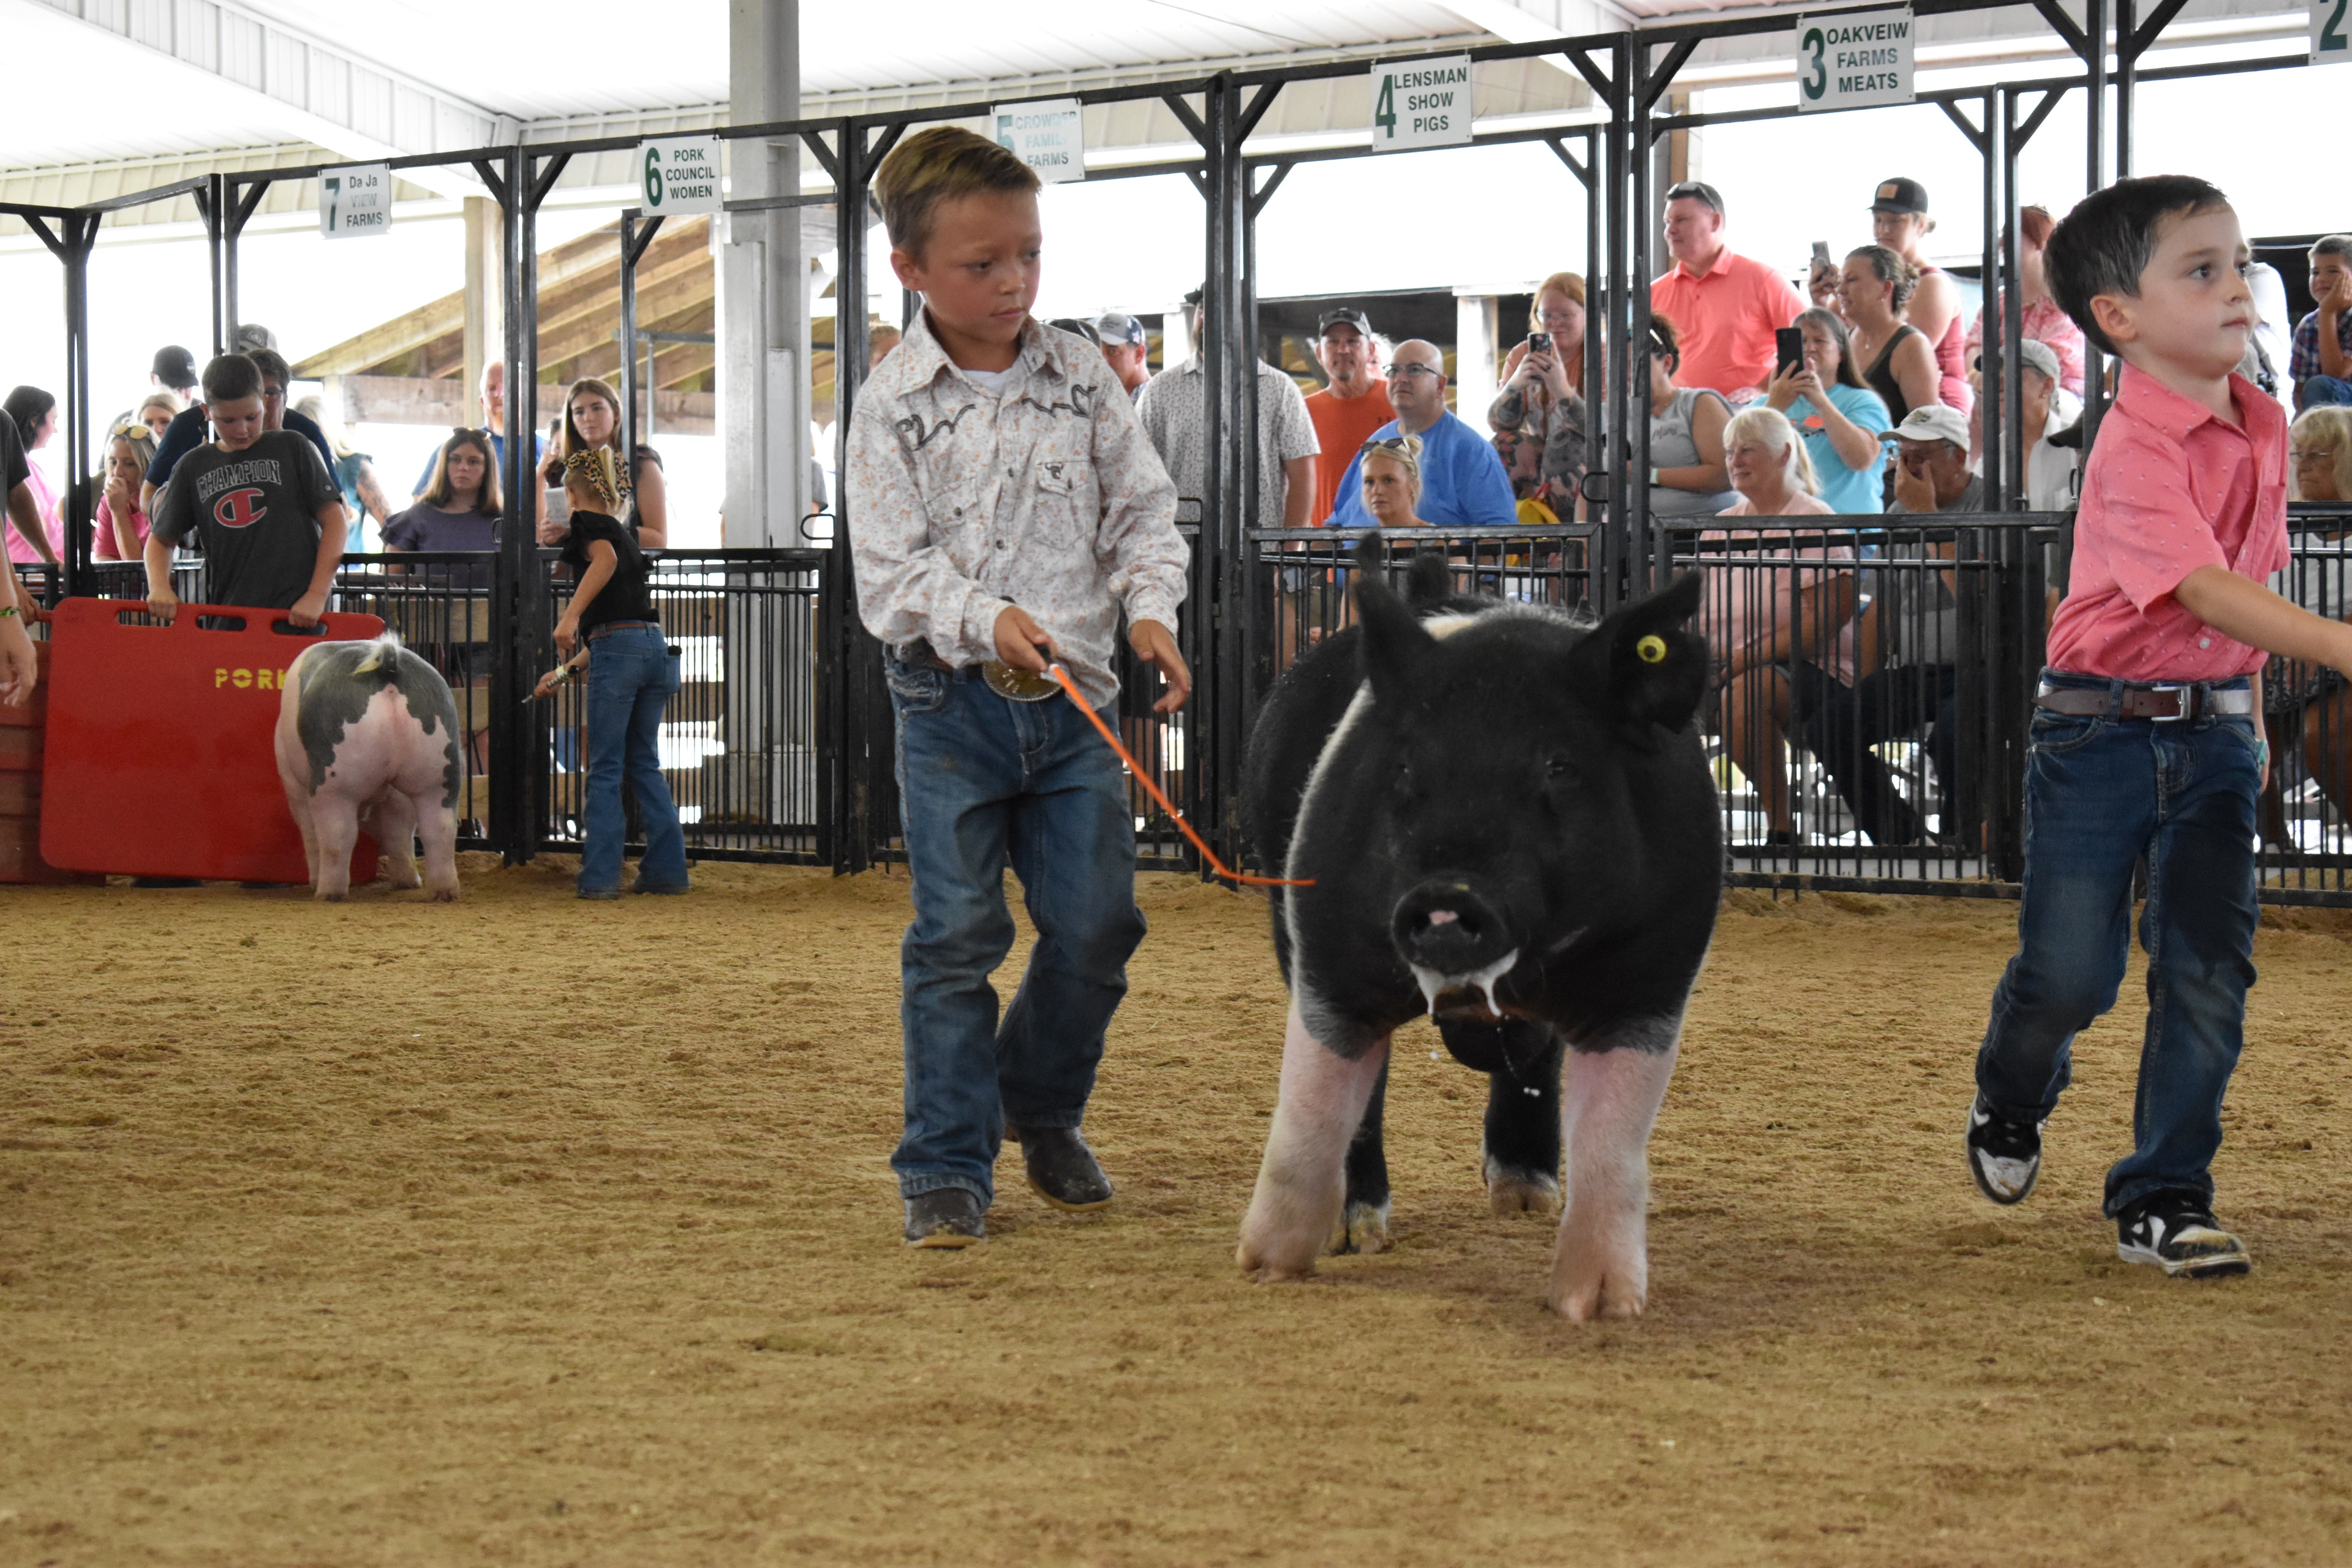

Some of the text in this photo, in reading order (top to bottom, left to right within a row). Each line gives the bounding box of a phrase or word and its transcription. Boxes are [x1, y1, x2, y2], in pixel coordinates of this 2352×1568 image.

[1826, 22, 1909, 45] OAKVEIW
[2319, 0, 2348, 51] 2
[1802, 28, 1826, 100] 3
[1838, 48, 1898, 69] FARMS
[1394, 67, 1466, 89] LENSMAN
[1839, 72, 1898, 92] MEATS
[1376, 74, 1396, 138] 4
[1409, 92, 1453, 110] SHOW
[1414, 115, 1449, 132] PIGS
[997, 115, 1016, 153] 5
[674, 148, 704, 162] PORK
[1027, 152, 1068, 167] FARMS
[350, 174, 377, 189] Da Ja
[645, 147, 663, 206] 6
[666, 167, 715, 181] COUNCIL
[351, 193, 377, 208] VIEW
[669, 185, 712, 199] WOMEN
[325, 177, 340, 231] 7
[347, 211, 383, 227] FARMS
[196, 459, 282, 503] CHAMPION
